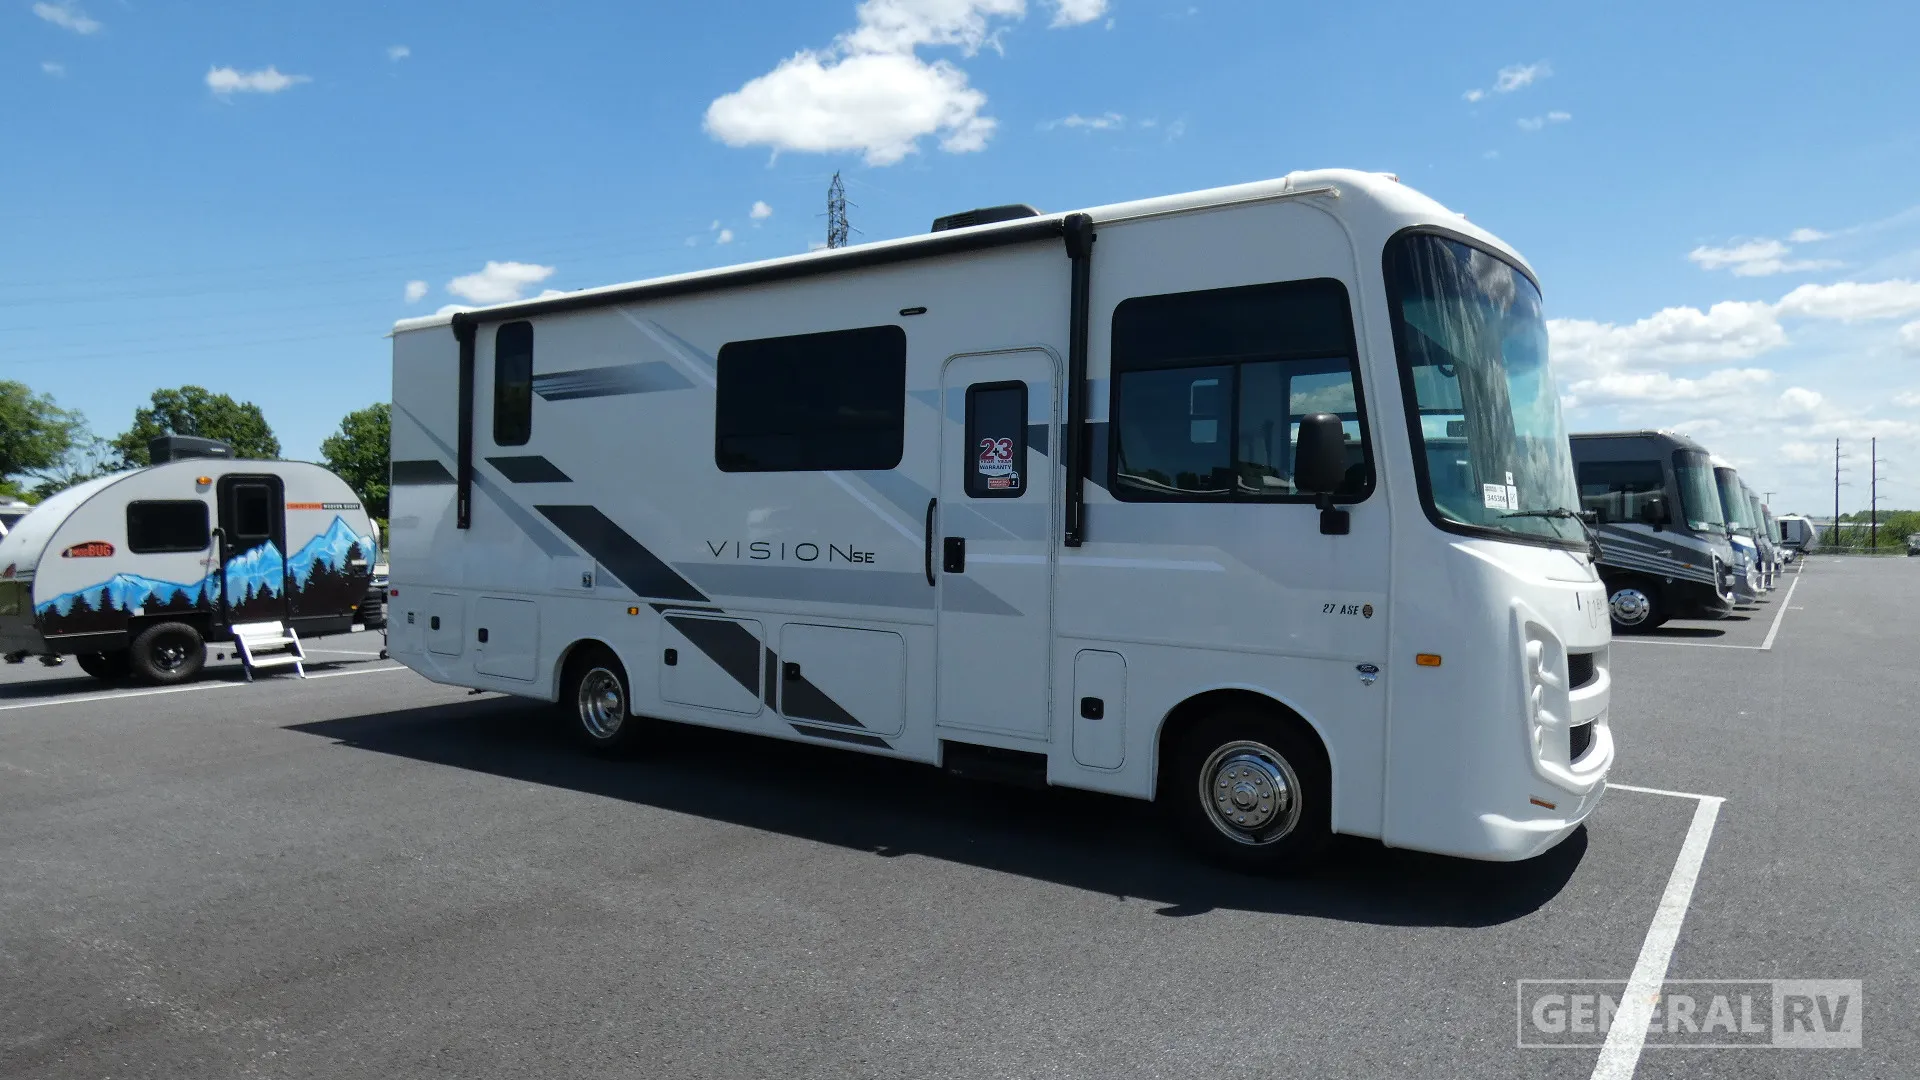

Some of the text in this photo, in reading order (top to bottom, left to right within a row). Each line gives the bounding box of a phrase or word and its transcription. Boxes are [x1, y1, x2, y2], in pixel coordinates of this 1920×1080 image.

[707, 541, 852, 562] VISION
[1323, 603, 1336, 614] 27
[1340, 604, 1360, 615] ASE
